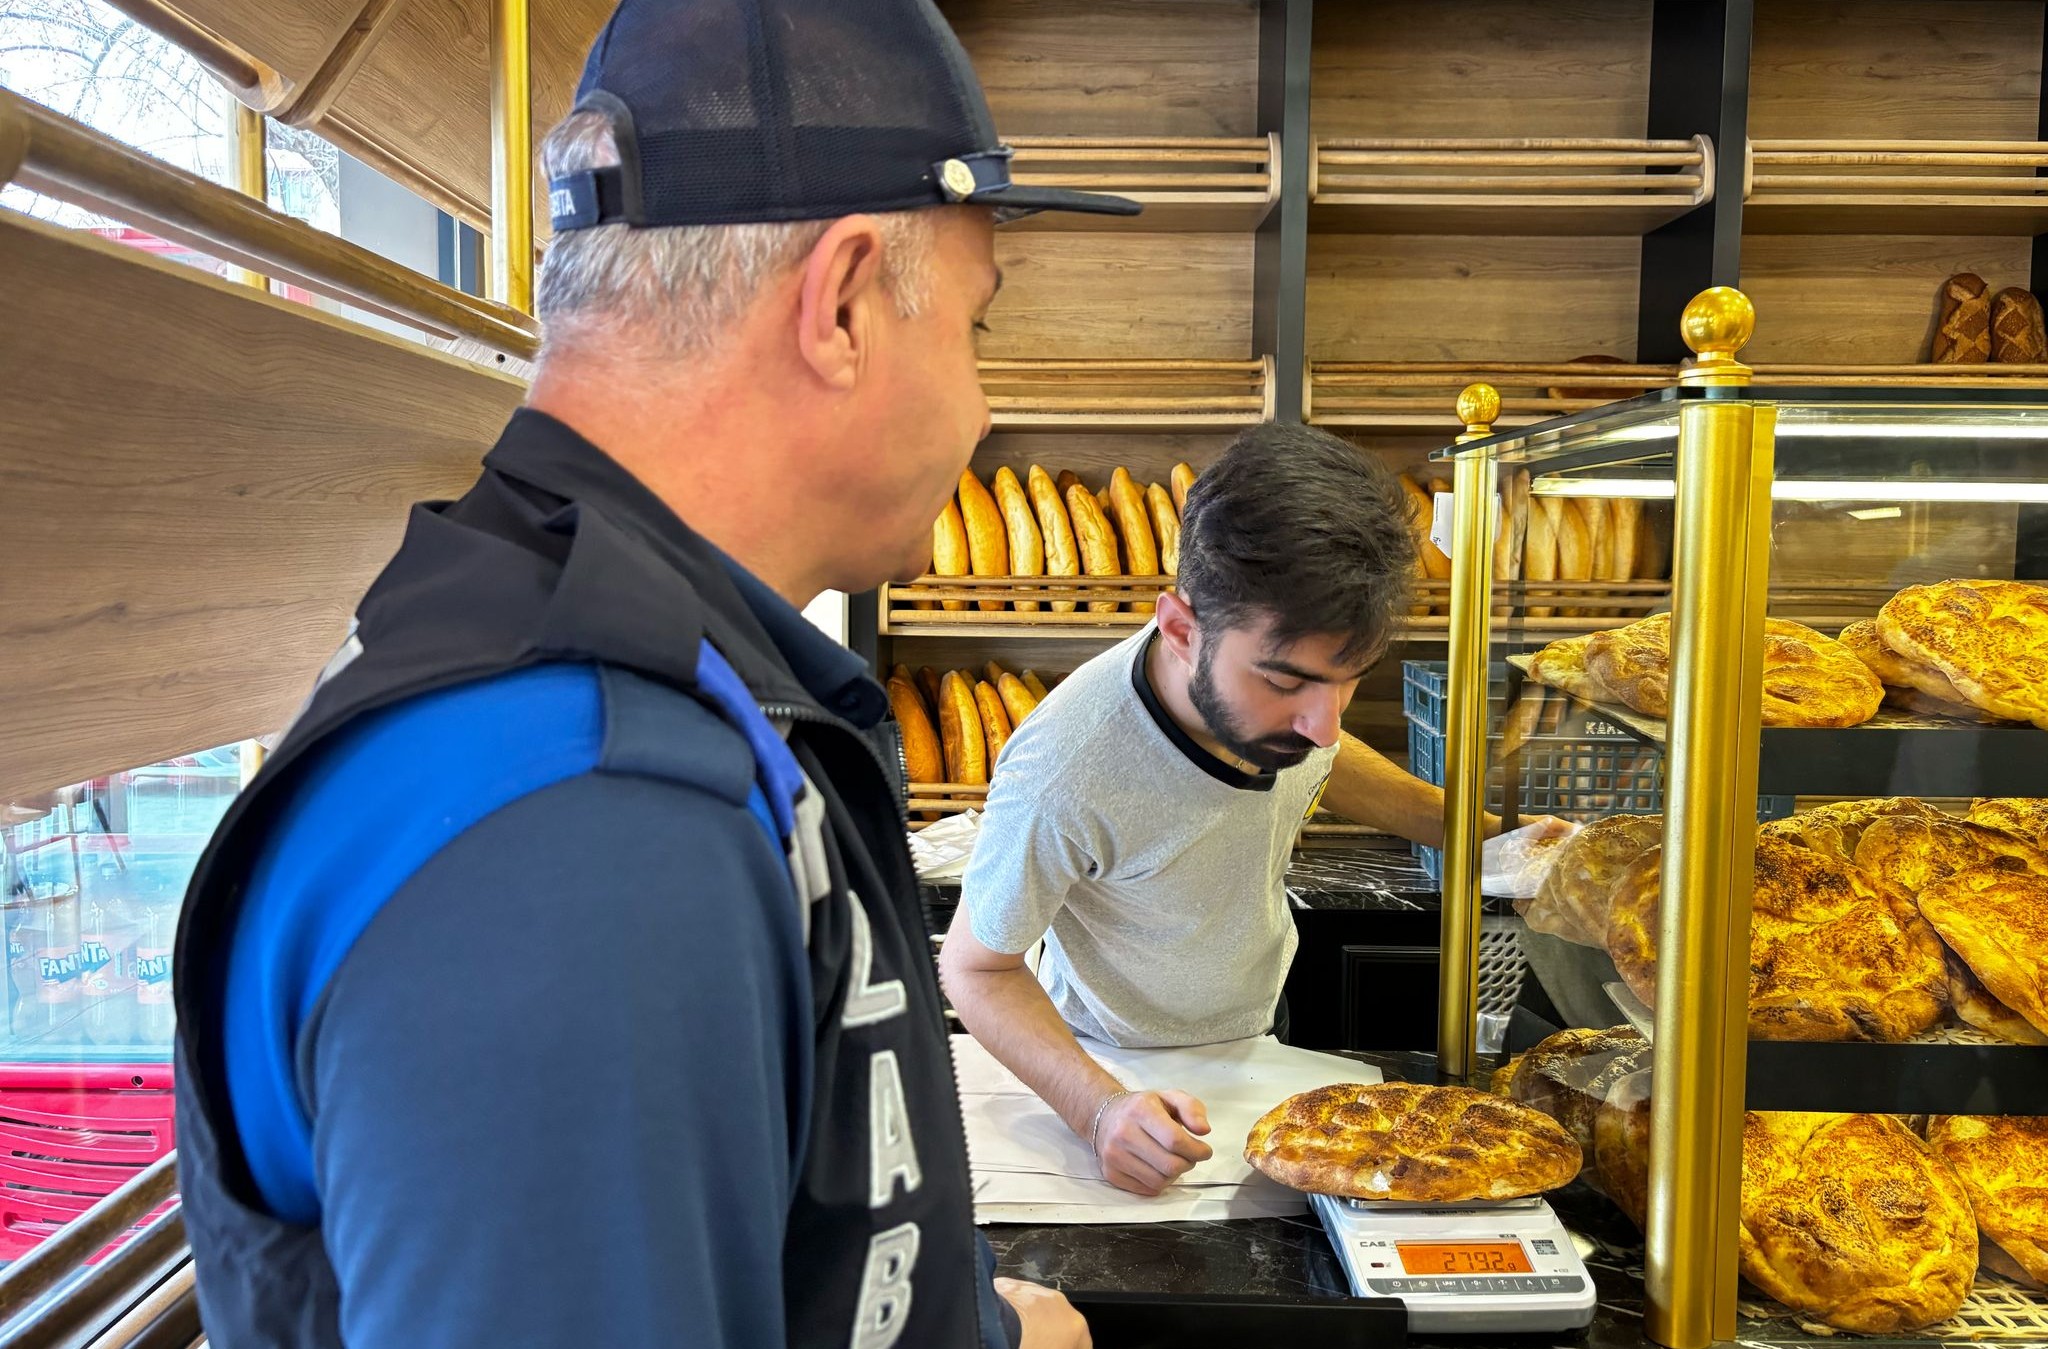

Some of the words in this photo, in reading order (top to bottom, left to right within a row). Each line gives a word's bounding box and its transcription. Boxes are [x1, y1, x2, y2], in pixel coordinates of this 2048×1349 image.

[10, 942, 25, 954] NTA
[81, 942, 110, 964] NTA
[137, 955, 171, 977] FANT
